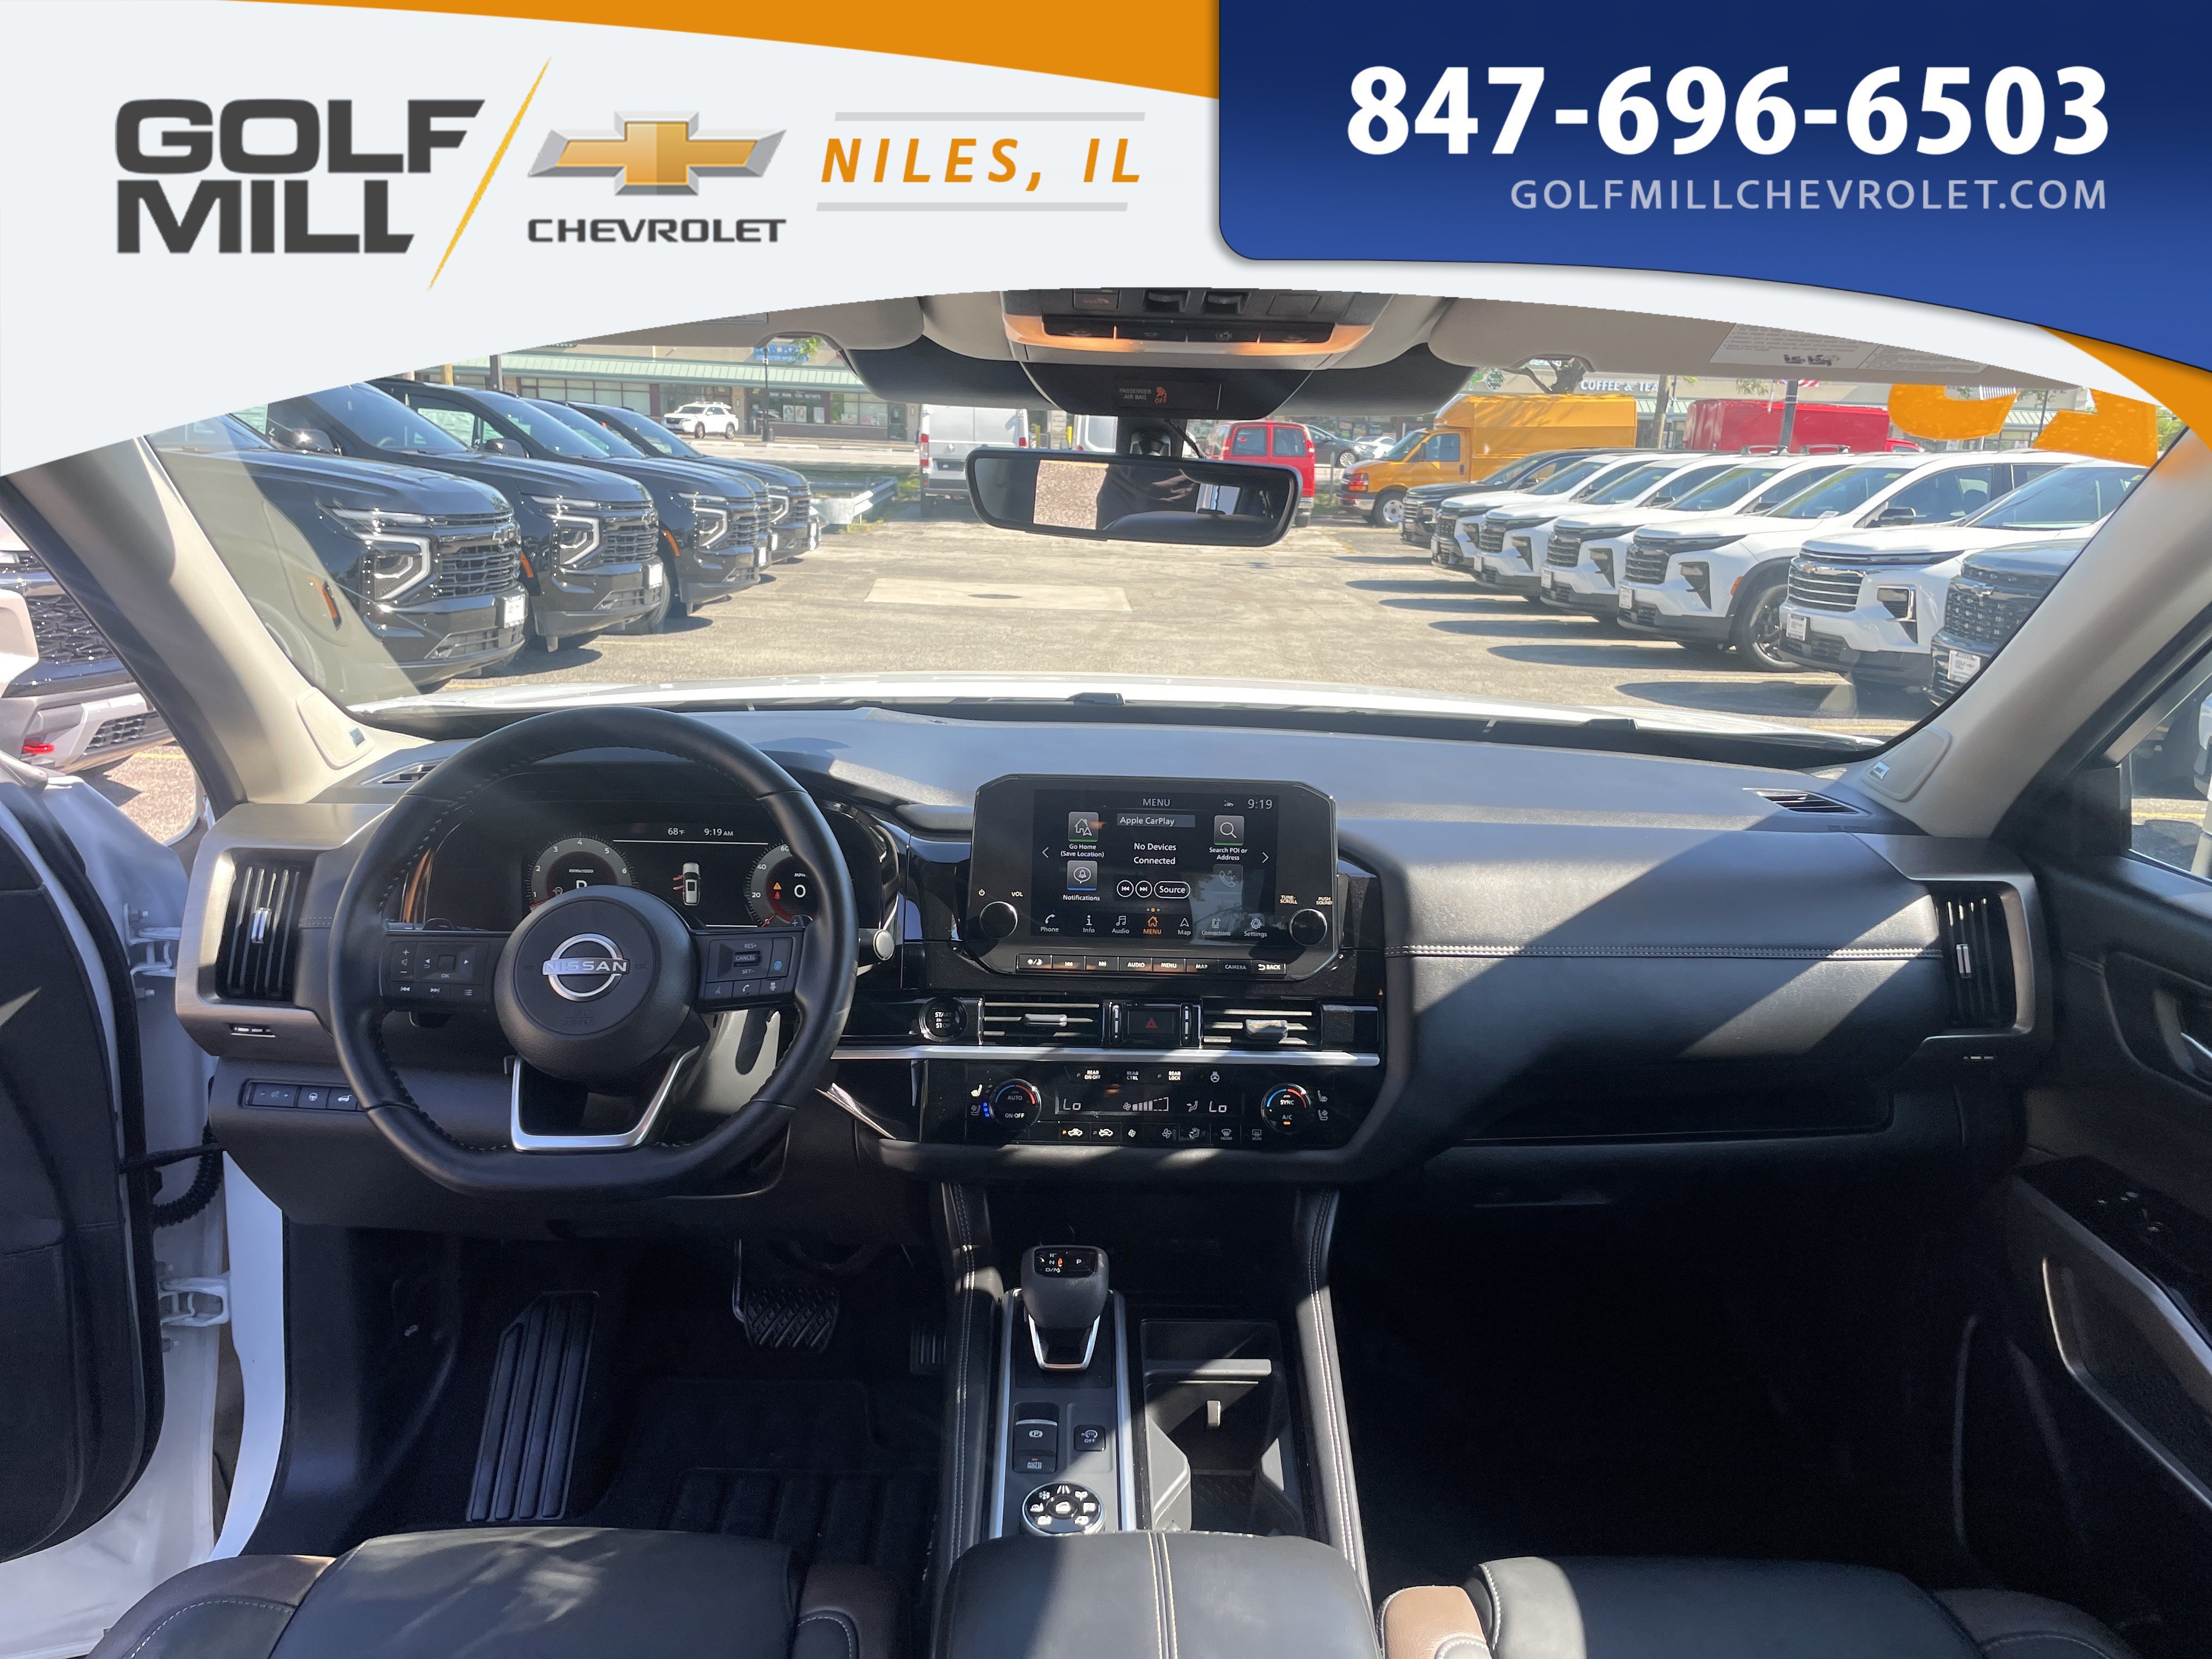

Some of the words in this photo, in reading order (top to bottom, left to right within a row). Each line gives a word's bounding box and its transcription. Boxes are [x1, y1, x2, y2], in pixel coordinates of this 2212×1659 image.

[1580, 380, 1620, 391] COFFEE
[1624, 382, 1633, 392] &
[1639, 382, 1659, 392] TEA
[1142, 798, 1170, 806] MENU
[1248, 799, 1273, 809] 9:19
[1120, 816, 1143, 825] Apple
[1145, 817, 1175, 826] CarPlay
[794, 884, 806, 898] 0
[544, 961, 627, 972] NISSAN
